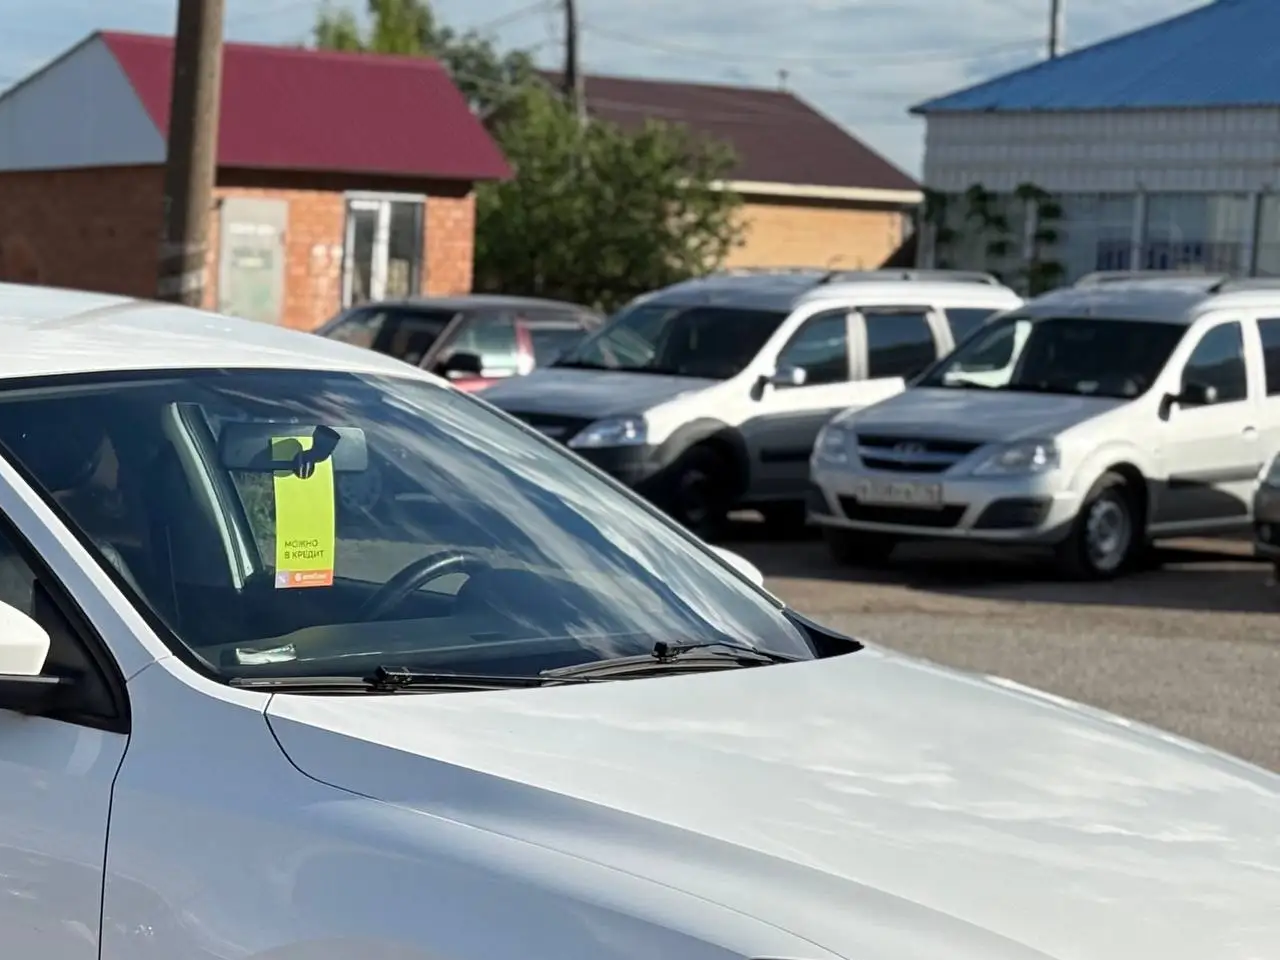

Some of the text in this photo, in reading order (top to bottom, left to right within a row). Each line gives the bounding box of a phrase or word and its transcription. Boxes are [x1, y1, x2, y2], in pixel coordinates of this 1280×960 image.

[284, 539, 319, 548] МОЖНО
[284, 550, 324, 560] В КРЕДИТ
